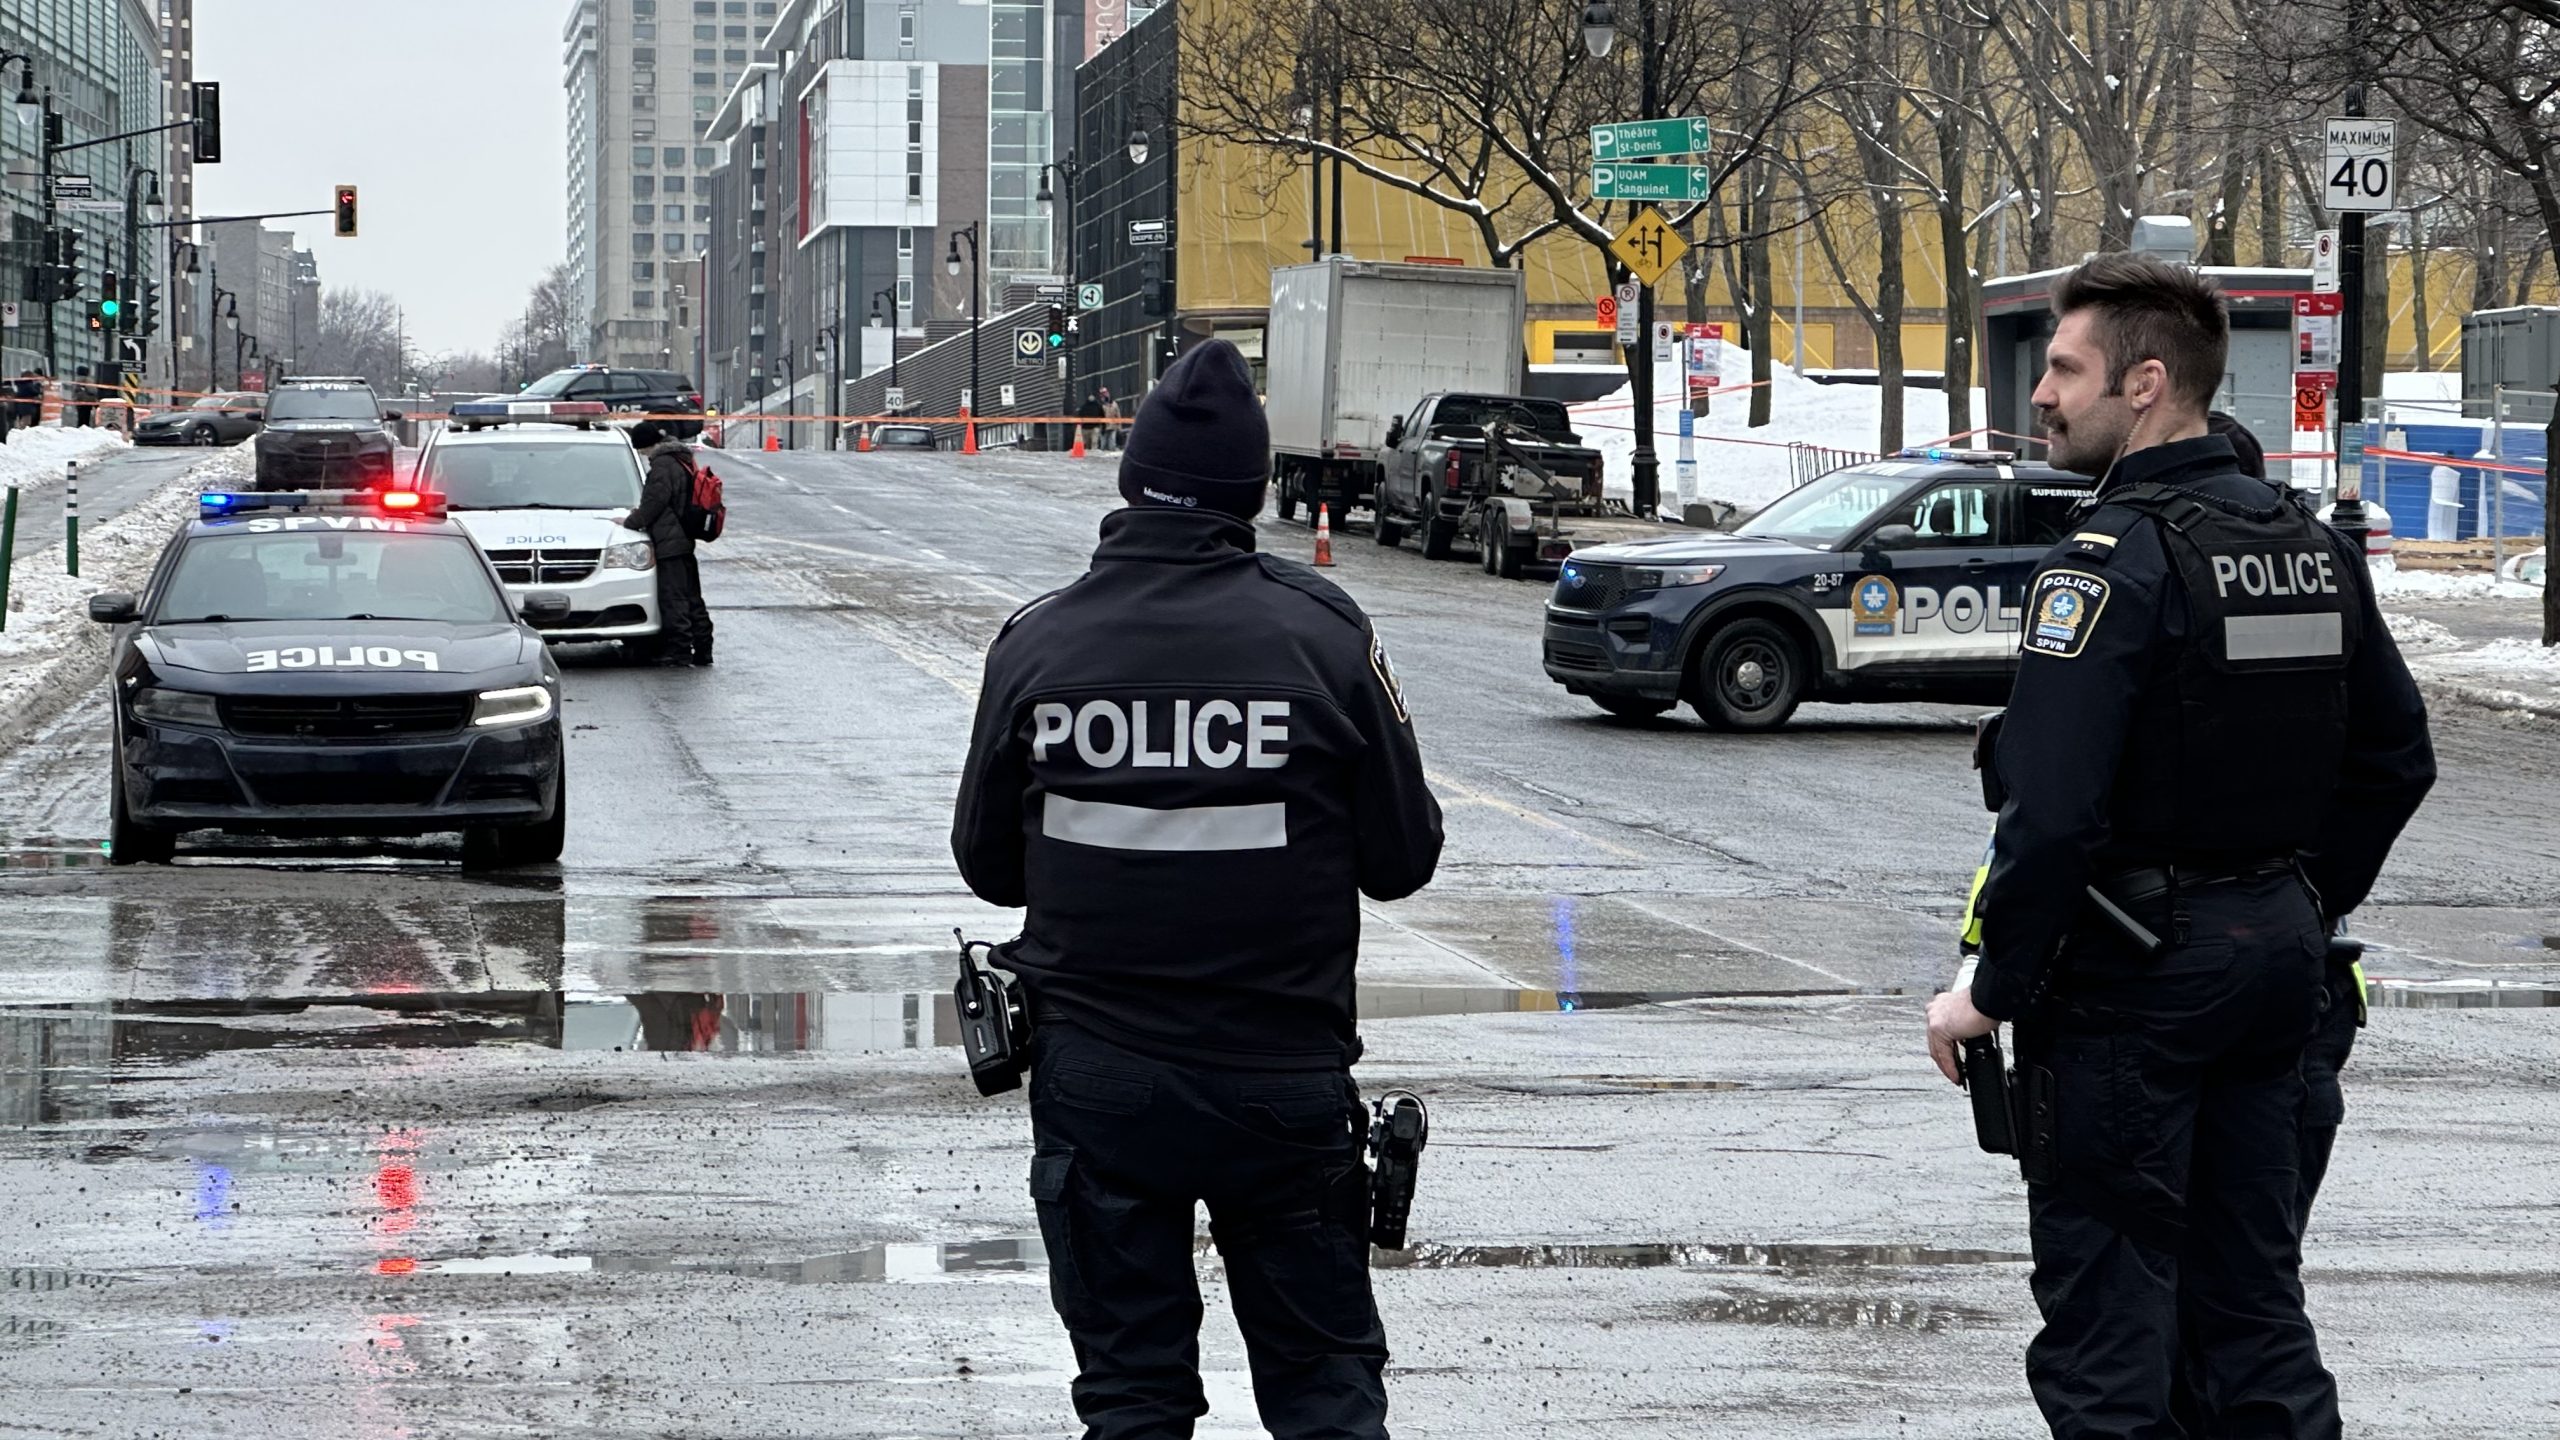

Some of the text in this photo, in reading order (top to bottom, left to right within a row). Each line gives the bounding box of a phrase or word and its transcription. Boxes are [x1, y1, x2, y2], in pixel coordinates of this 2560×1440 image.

[1618, 127, 1658, 140] Théâtre
[2329, 131, 2391, 146] MAXIMUM
[1620, 139, 1663, 153] St-Denis
[1618, 170, 1647, 181] UQAM
[2330, 157, 2388, 197] 40
[1618, 184, 1669, 196] Sanguinet
[299, 383, 349, 391] SPVM
[887, 396, 901, 407] 40
[248, 516, 407, 532] SPVM
[1813, 573, 1844, 587] 20-87
[2211, 552, 2339, 598] POLICE
[2042, 576, 2103, 597] POLICE
[2036, 638, 2066, 652] SPVM
[1033, 699, 1290, 769] POLICE
